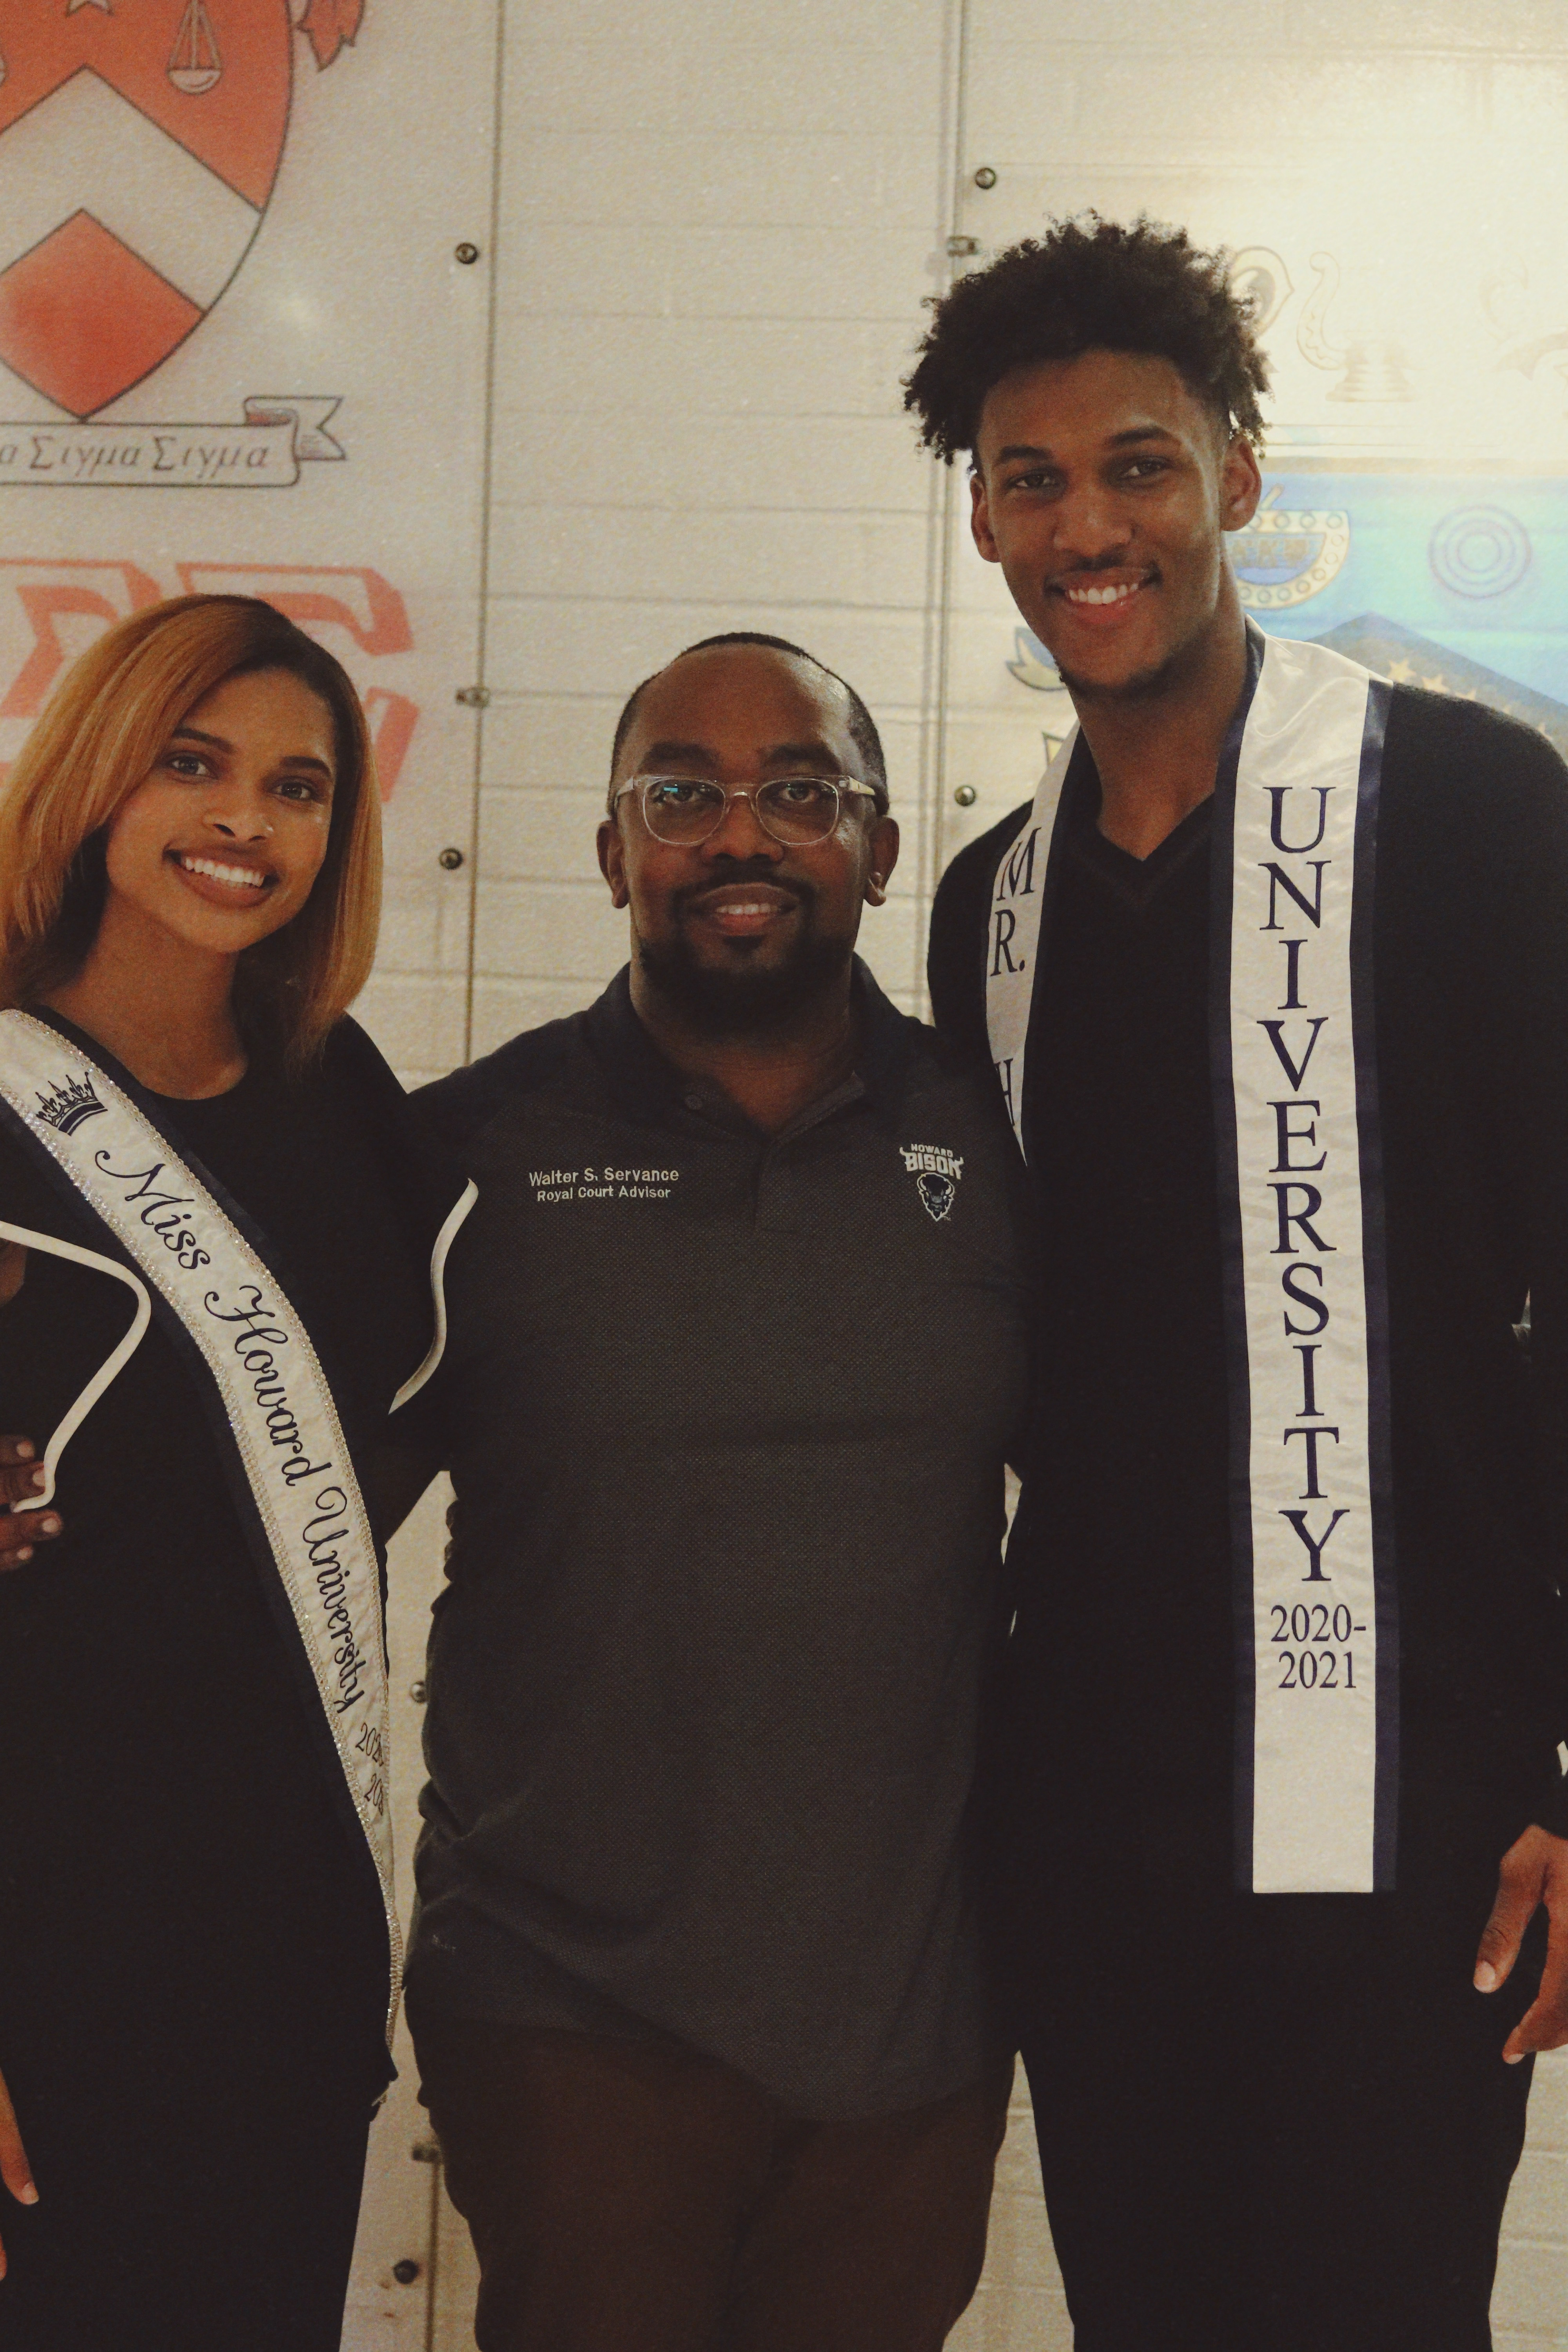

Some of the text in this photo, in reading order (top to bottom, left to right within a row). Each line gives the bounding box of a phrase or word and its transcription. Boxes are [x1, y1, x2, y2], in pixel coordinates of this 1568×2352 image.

[900, 1147, 964, 1180] BISON
[911, 1143, 953, 1158] HOWARD
[529, 1167, 679, 1187] Walter S. Servance
[537, 1185, 671, 1202] Royal Court Advisor
[1256, 786, 1350, 1581] UNIVERSITY
[95, 1150, 366, 1713] Miss Howard University
[1270, 1604, 1366, 1642] 2020-
[1278, 1650, 1356, 1688] 2021
